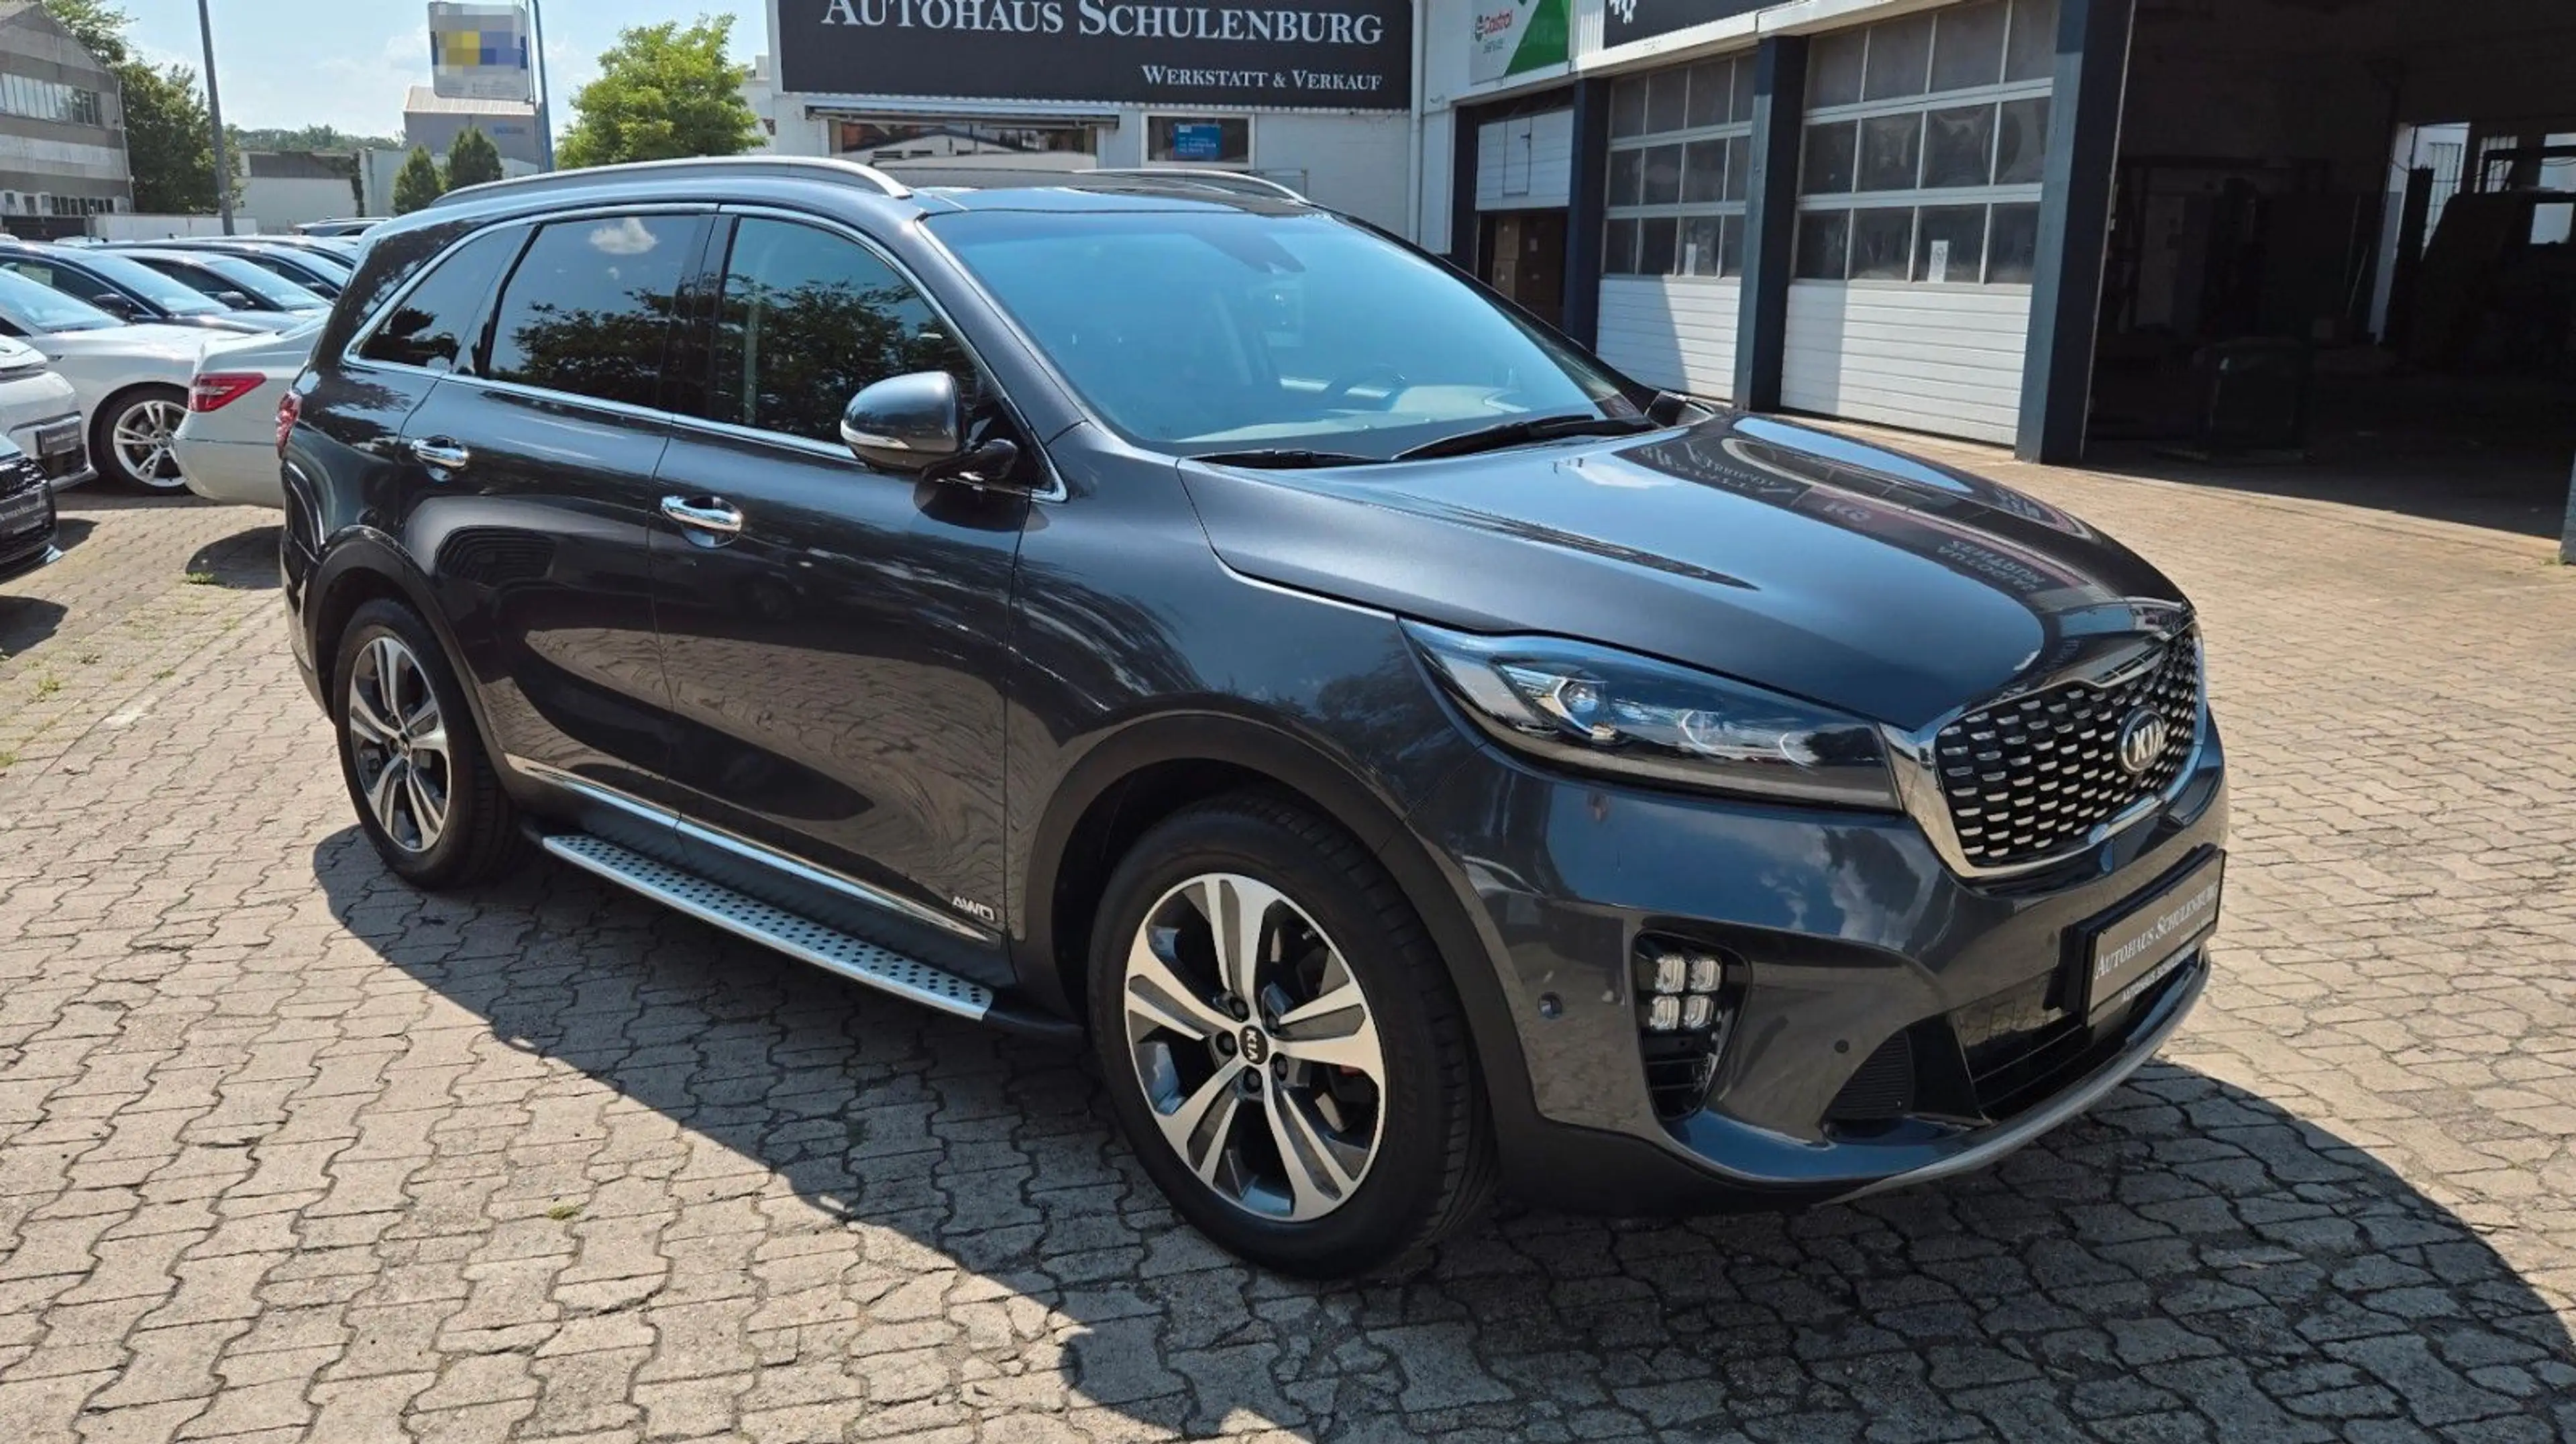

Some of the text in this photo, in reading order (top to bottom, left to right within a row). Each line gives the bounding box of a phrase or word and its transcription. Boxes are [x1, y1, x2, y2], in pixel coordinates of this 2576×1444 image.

[821, 0, 1384, 44] AUTOHAUS SCHULENBURG
[1141, 65, 1382, 91] WERKSTATT & VERKAUF
[2132, 718, 2163, 762] KIA
[953, 896, 994, 921] AWD
[2093, 929, 2154, 980] AUTOHAUS
[1246, 1028, 1258, 1061] KIA
